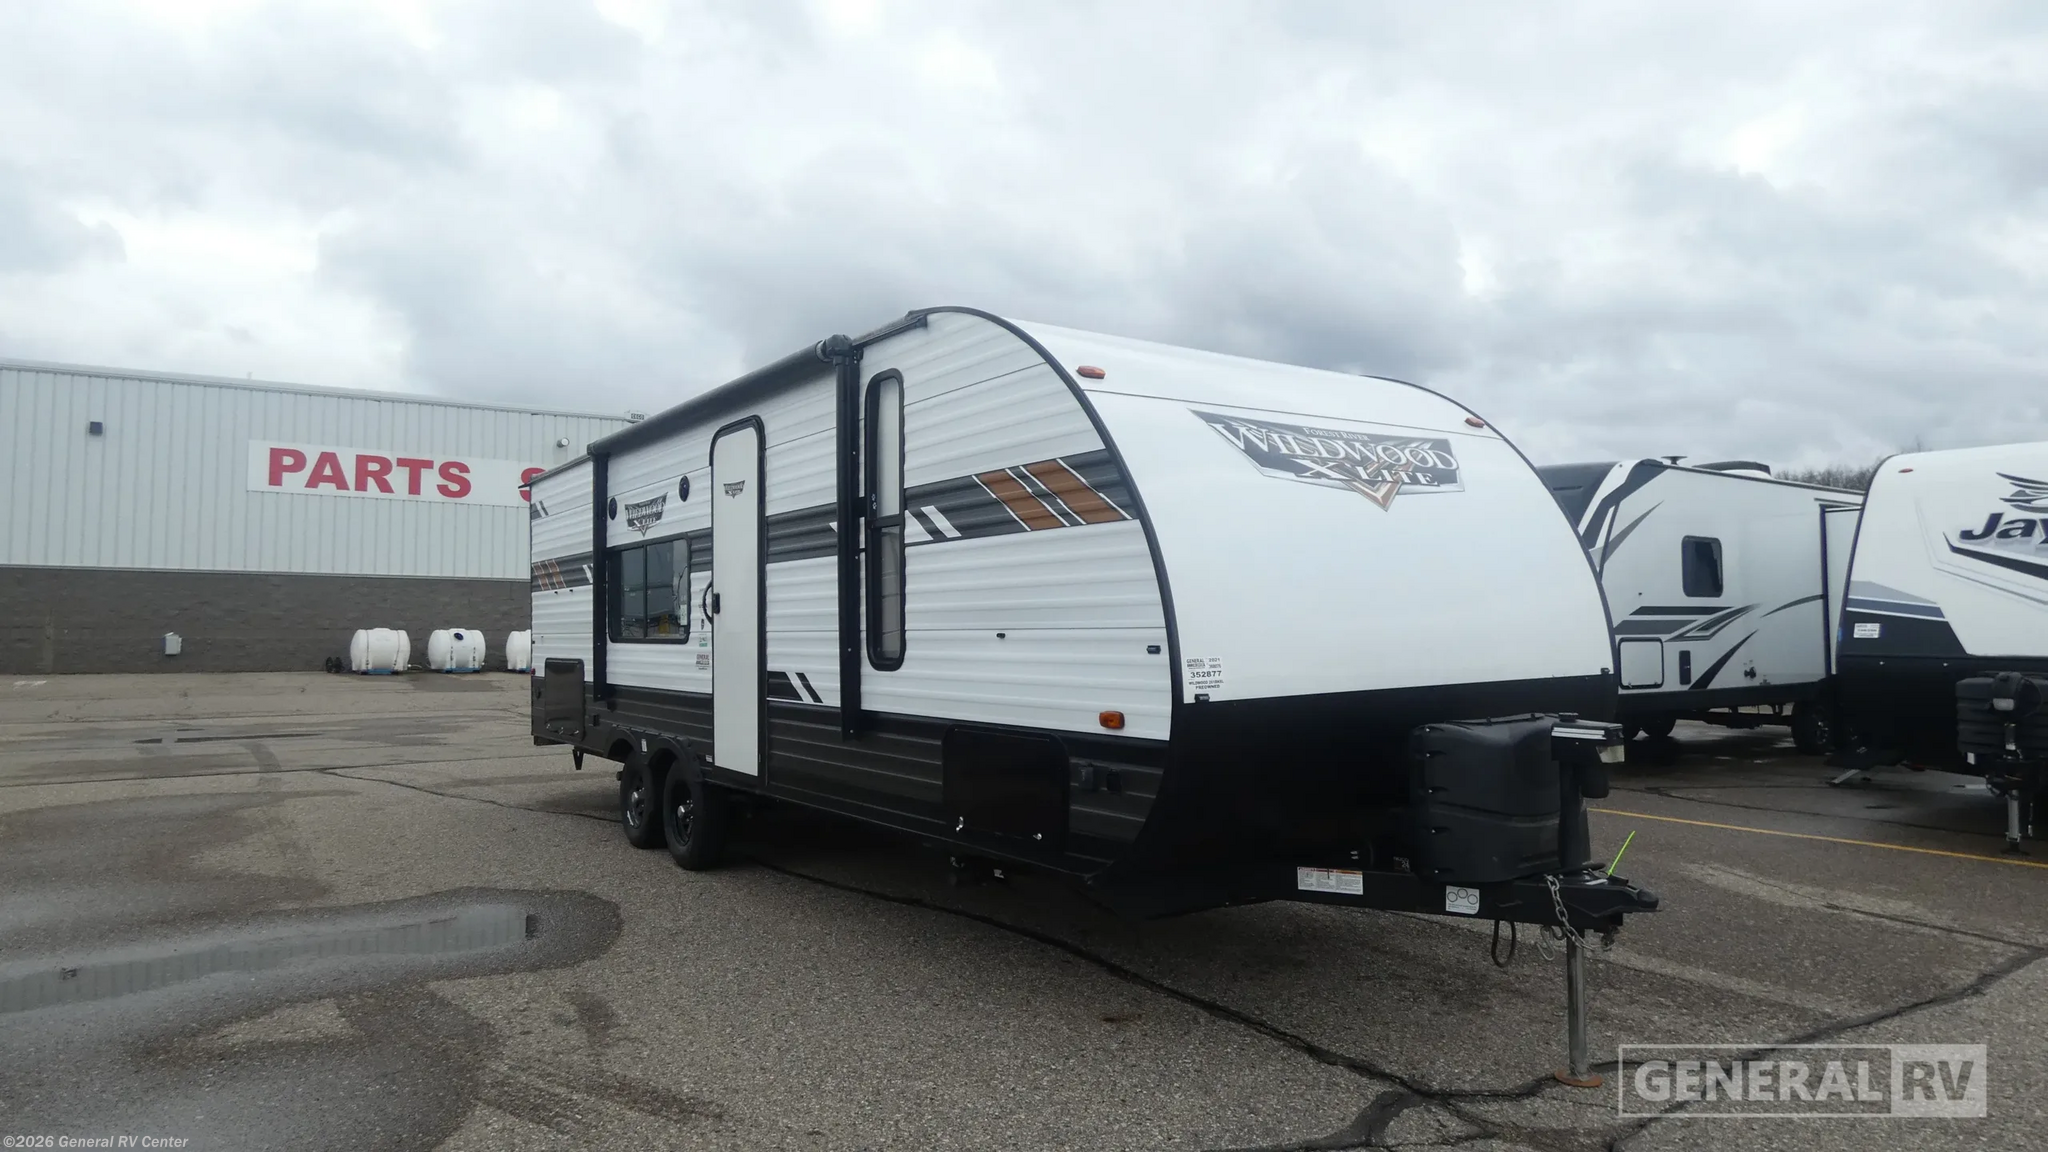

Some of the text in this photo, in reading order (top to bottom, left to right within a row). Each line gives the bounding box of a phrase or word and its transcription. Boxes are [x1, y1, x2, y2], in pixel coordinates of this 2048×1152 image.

[1209, 422, 1460, 470] WILDWOOD
[1303, 427, 1370, 441] FOREST RIVER
[268, 447, 472, 498] PARTS
[1959, 512, 2048, 544] Ja
[1190, 670, 1222, 678] 352877
